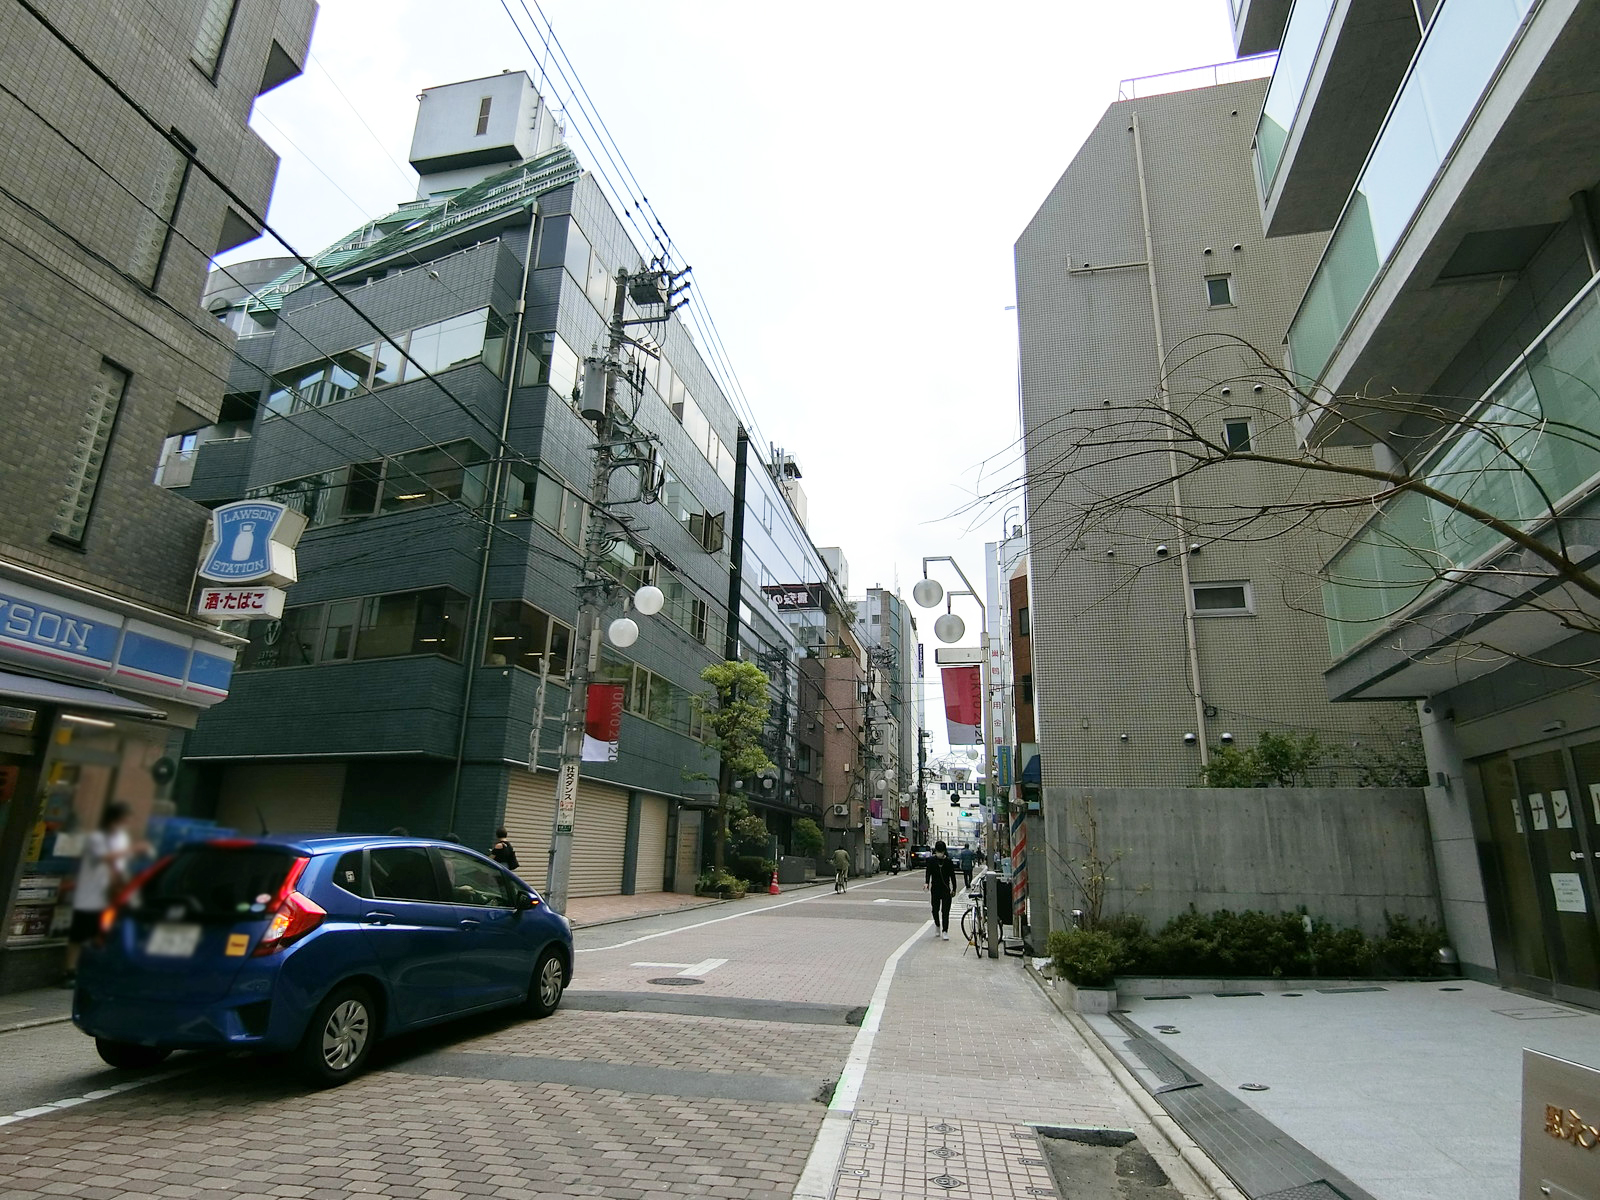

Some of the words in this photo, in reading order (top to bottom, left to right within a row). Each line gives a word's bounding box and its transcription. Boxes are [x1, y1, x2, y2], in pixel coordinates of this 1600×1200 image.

[223, 509, 276, 523] LAWSON
[211, 559, 265, 573] STATION
[204, 592, 265, 609] 酒・たばこ
[564, 765, 576, 800] 社交ダンス
